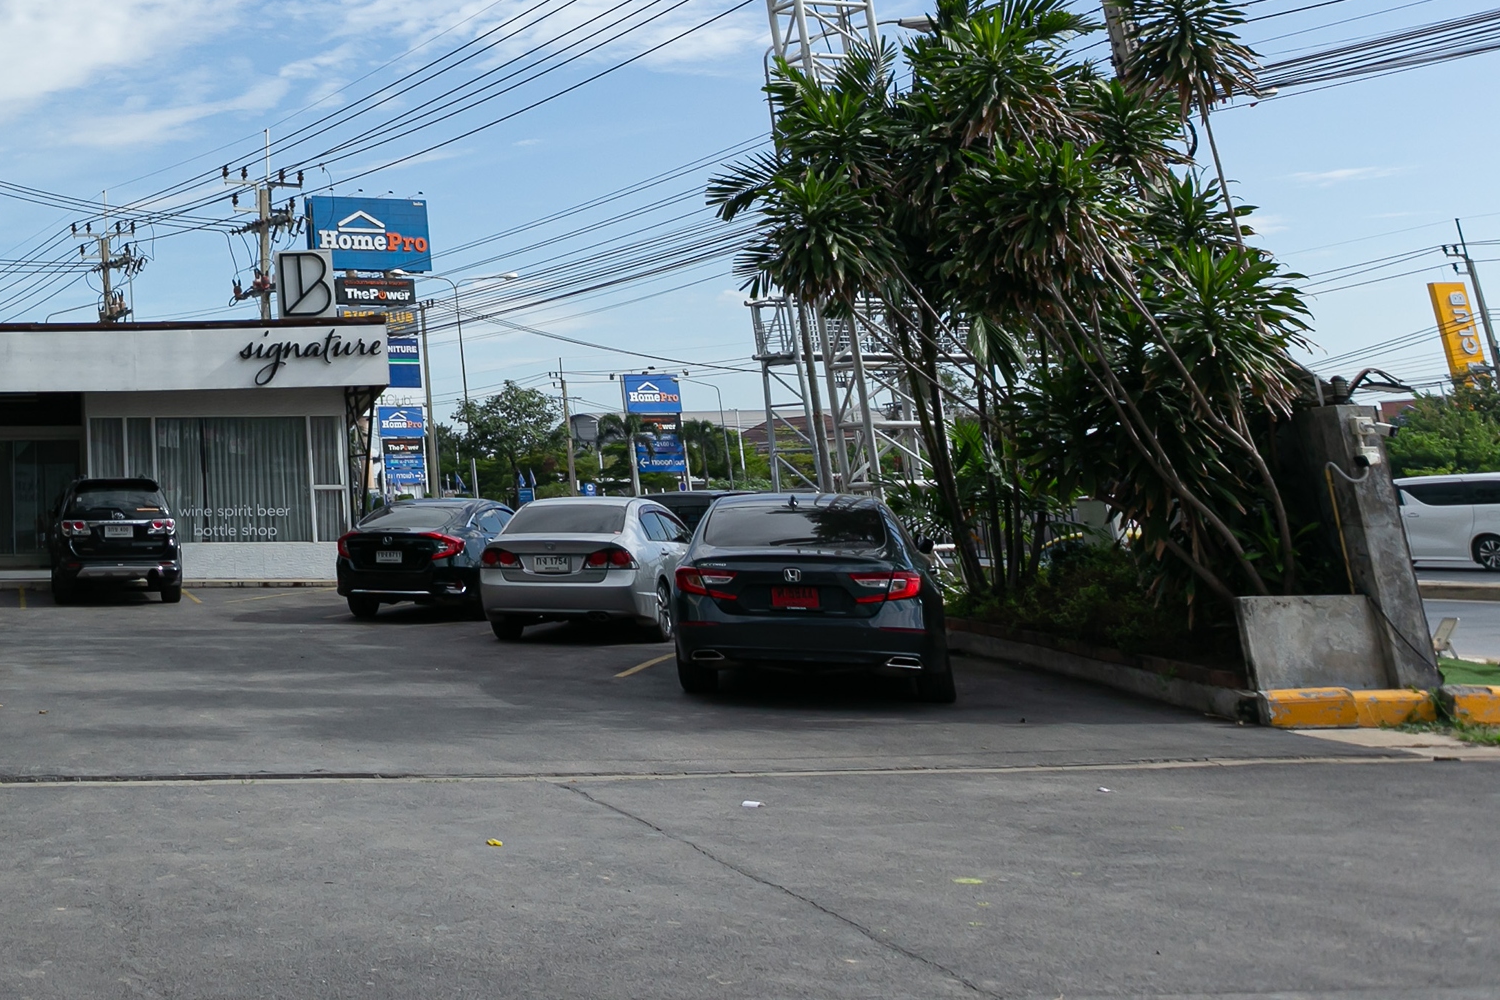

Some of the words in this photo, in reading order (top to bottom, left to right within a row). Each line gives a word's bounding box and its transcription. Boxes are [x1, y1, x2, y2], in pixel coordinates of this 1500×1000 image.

[318, 230, 428, 251] HomePro
[1449, 291, 1479, 355] CLUB
[239, 329, 382, 386] signature
[629, 391, 679, 402] HomePro
[382, 420, 423, 429] HomePro
[179, 504, 212, 517] wine
[218, 504, 253, 519] spirit
[257, 504, 290, 517] beer
[194, 523, 237, 537] bottle
[242, 524, 277, 539] shop
[550, 557, 567, 565] 1754
